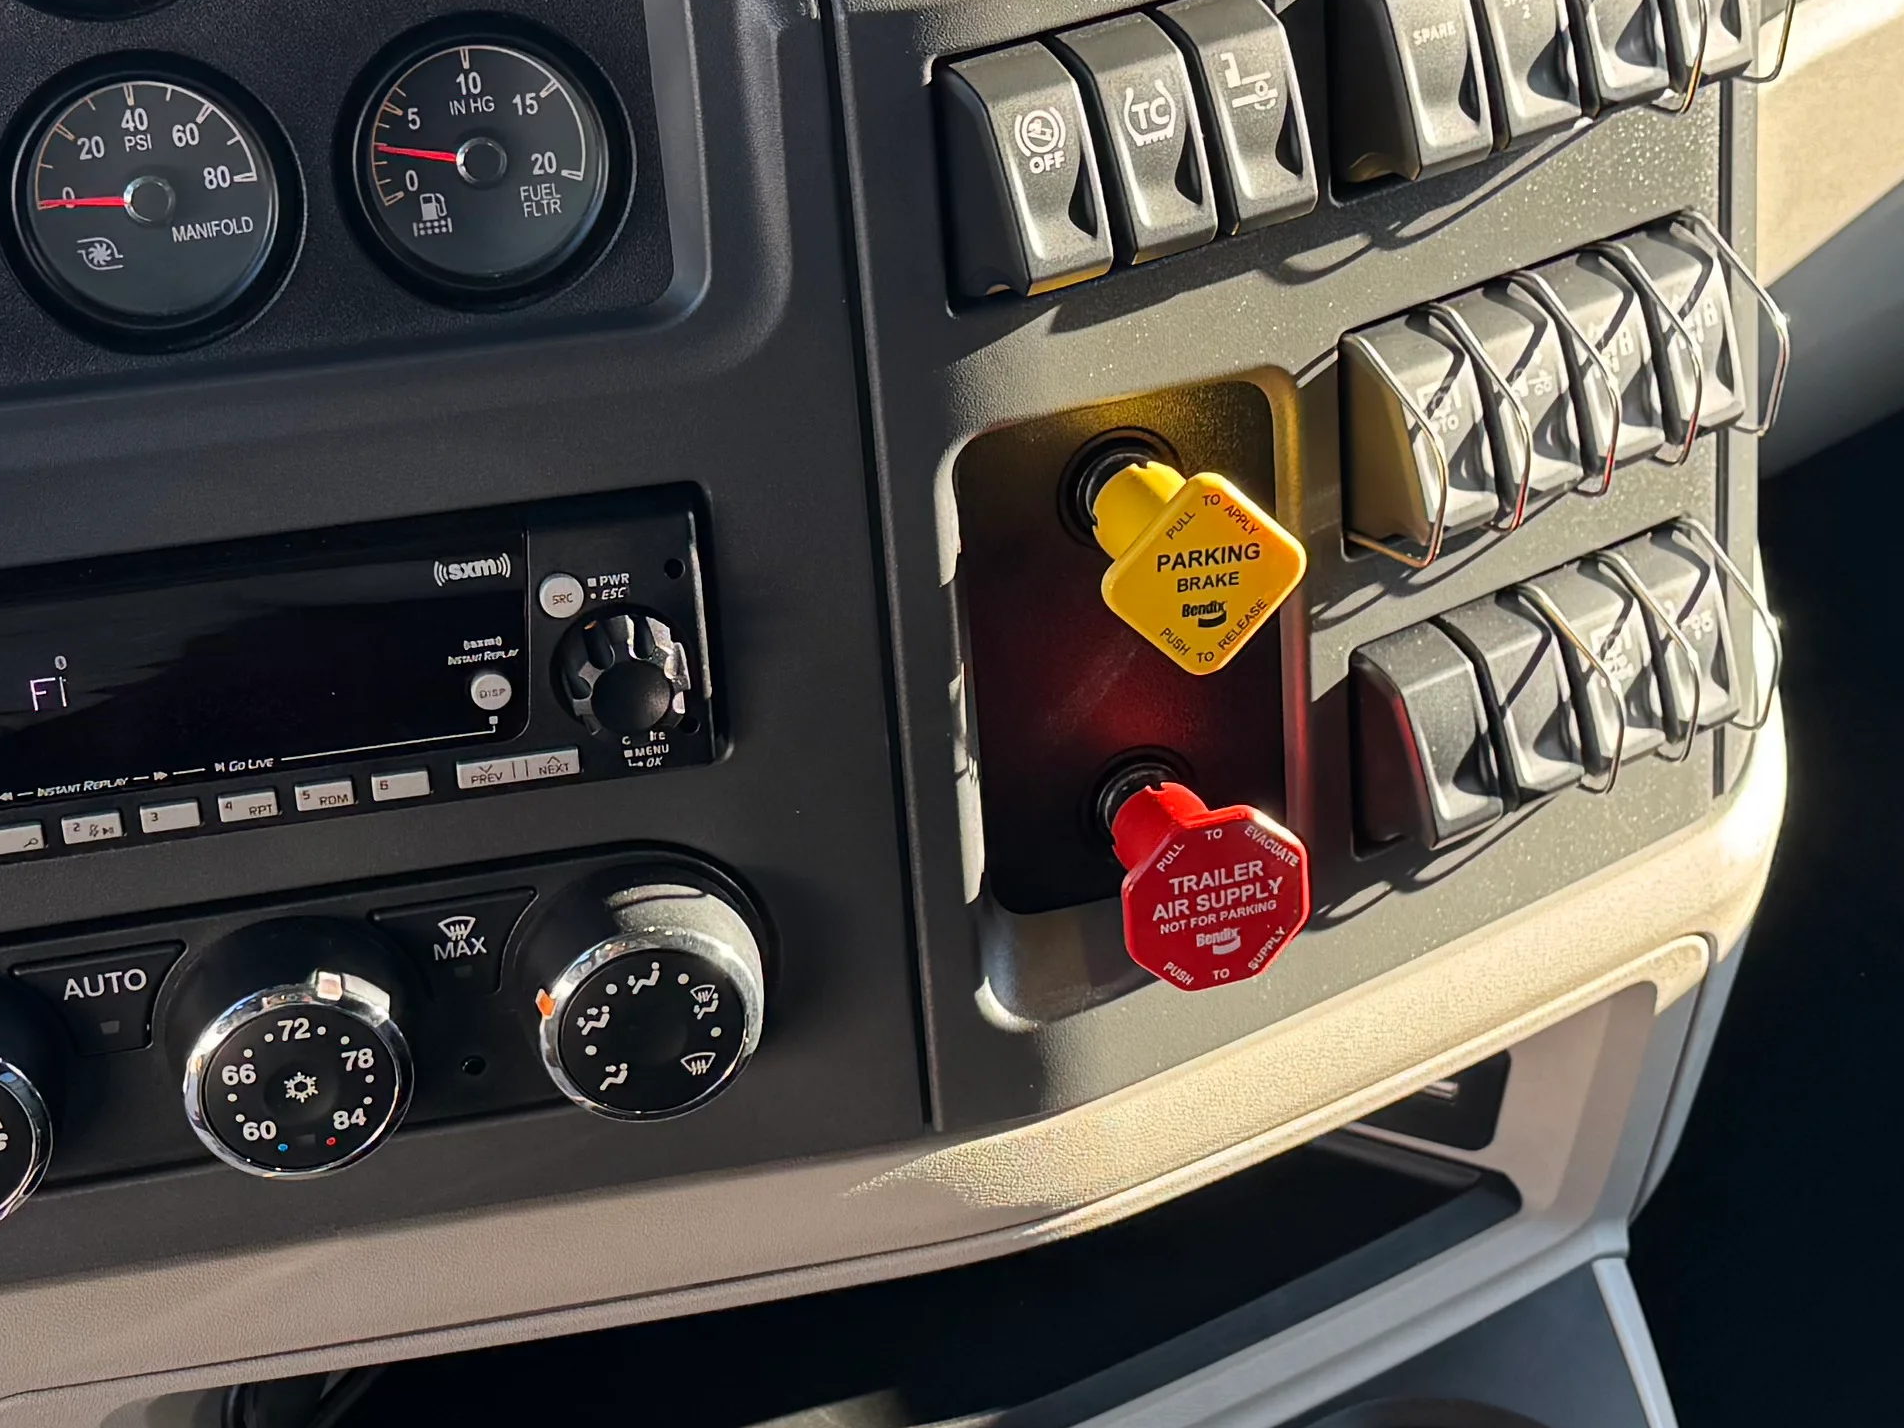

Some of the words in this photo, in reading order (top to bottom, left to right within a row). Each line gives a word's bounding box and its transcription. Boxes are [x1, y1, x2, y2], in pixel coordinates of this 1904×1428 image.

[1413, 21, 1457, 45] SPARE
[456, 72, 482, 95] 10
[449, 101, 466, 116] IN
[471, 96, 495, 114] HG
[512, 92, 539, 116] 15
[1131, 96, 1170, 129] TC
[121, 108, 148, 132] 40
[408, 108, 421, 130] 5
[124, 133, 152, 152] PSI
[172, 123, 199, 148] 60
[77, 135, 105, 161] 20
[531, 152, 556, 175] 20
[1029, 150, 1065, 174] OFF
[203, 165, 230, 189] 80
[406, 170, 419, 191] 0
[520, 183, 561, 201] FUEL
[523, 199, 562, 218] FLTR
[172, 216, 254, 243] MANIFOLD
[1166, 511, 1196, 540] PULL
[1202, 494, 1221, 506] TO
[1224, 505, 1260, 536] APPLY
[1157, 543, 1261, 572] PARKING
[599, 573, 630, 587] PWR
[1177, 571, 1240, 593] BRAKE
[552, 594, 574, 605] SRC
[601, 587, 627, 600] ESC
[1182, 600, 1227, 619] Bendix
[1160, 627, 1191, 656] PUSH
[1196, 651, 1215, 663] TO
[1218, 598, 1268, 650] RELEASE
[480, 688, 506, 699] DISP
[635, 744, 669, 757] MENU
[646, 756, 663, 767] OK
[470, 772, 503, 784] PREV
[539, 762, 570, 775] NEXT
[37, 783, 81, 797] INSTANT
[84, 777, 128, 791] REPLAY
[302, 790, 311, 800] 5
[380, 779, 389, 791] 6
[150, 811, 159, 822] 3
[224, 800, 233, 811] 4
[248, 803, 273, 816] RPT
[72, 822, 80, 832] 2
[1156, 843, 1185, 872] PULL
[1205, 828, 1223, 840] TO
[1244, 825, 1300, 867] EVACUATE
[1169, 860, 1264, 895] TRAILER
[1152, 899, 1190, 922] AIR
[1196, 876, 1283, 912] SUPPLY
[1160, 921, 1187, 935] NOT
[1190, 914, 1217, 928] FOR
[1219, 900, 1277, 922] PARKING
[433, 936, 487, 961] MAX
[1196, 927, 1240, 948] Bendix
[1163, 961, 1194, 986] PUSH
[1212, 968, 1230, 980] TO
[1248, 926, 1286, 970] SUPPLY
[63, 968, 147, 1001] AUTO
[277, 1018, 311, 1041] 72
[341, 1048, 374, 1072] 78
[221, 1063, 256, 1086] 66
[332, 1107, 367, 1130] 84
[242, 1120, 277, 1141] 60
